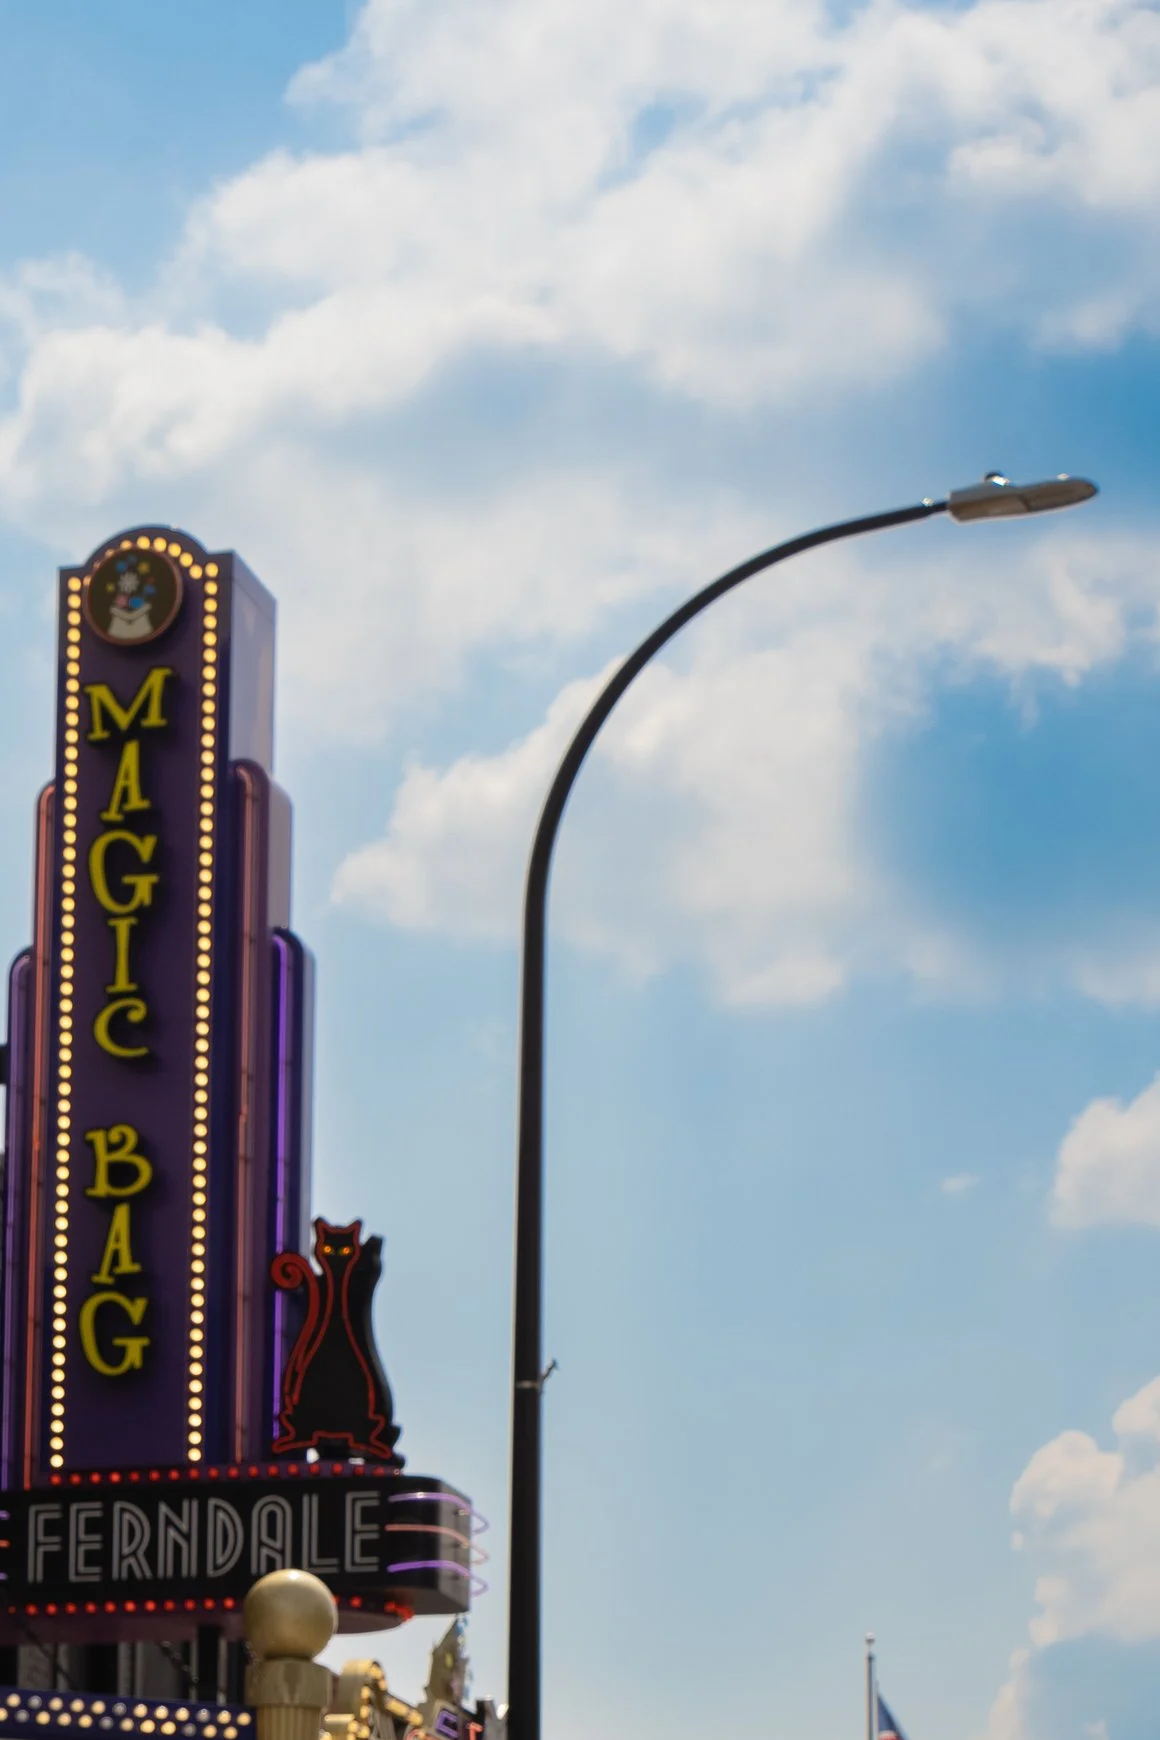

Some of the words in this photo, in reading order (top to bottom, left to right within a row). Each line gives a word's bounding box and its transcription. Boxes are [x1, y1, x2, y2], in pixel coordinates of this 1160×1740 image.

[84, 667, 173, 1058] MAGIC
[79, 1124, 153, 1376] BAG
[27, 1490, 380, 1584] FERNDALE
